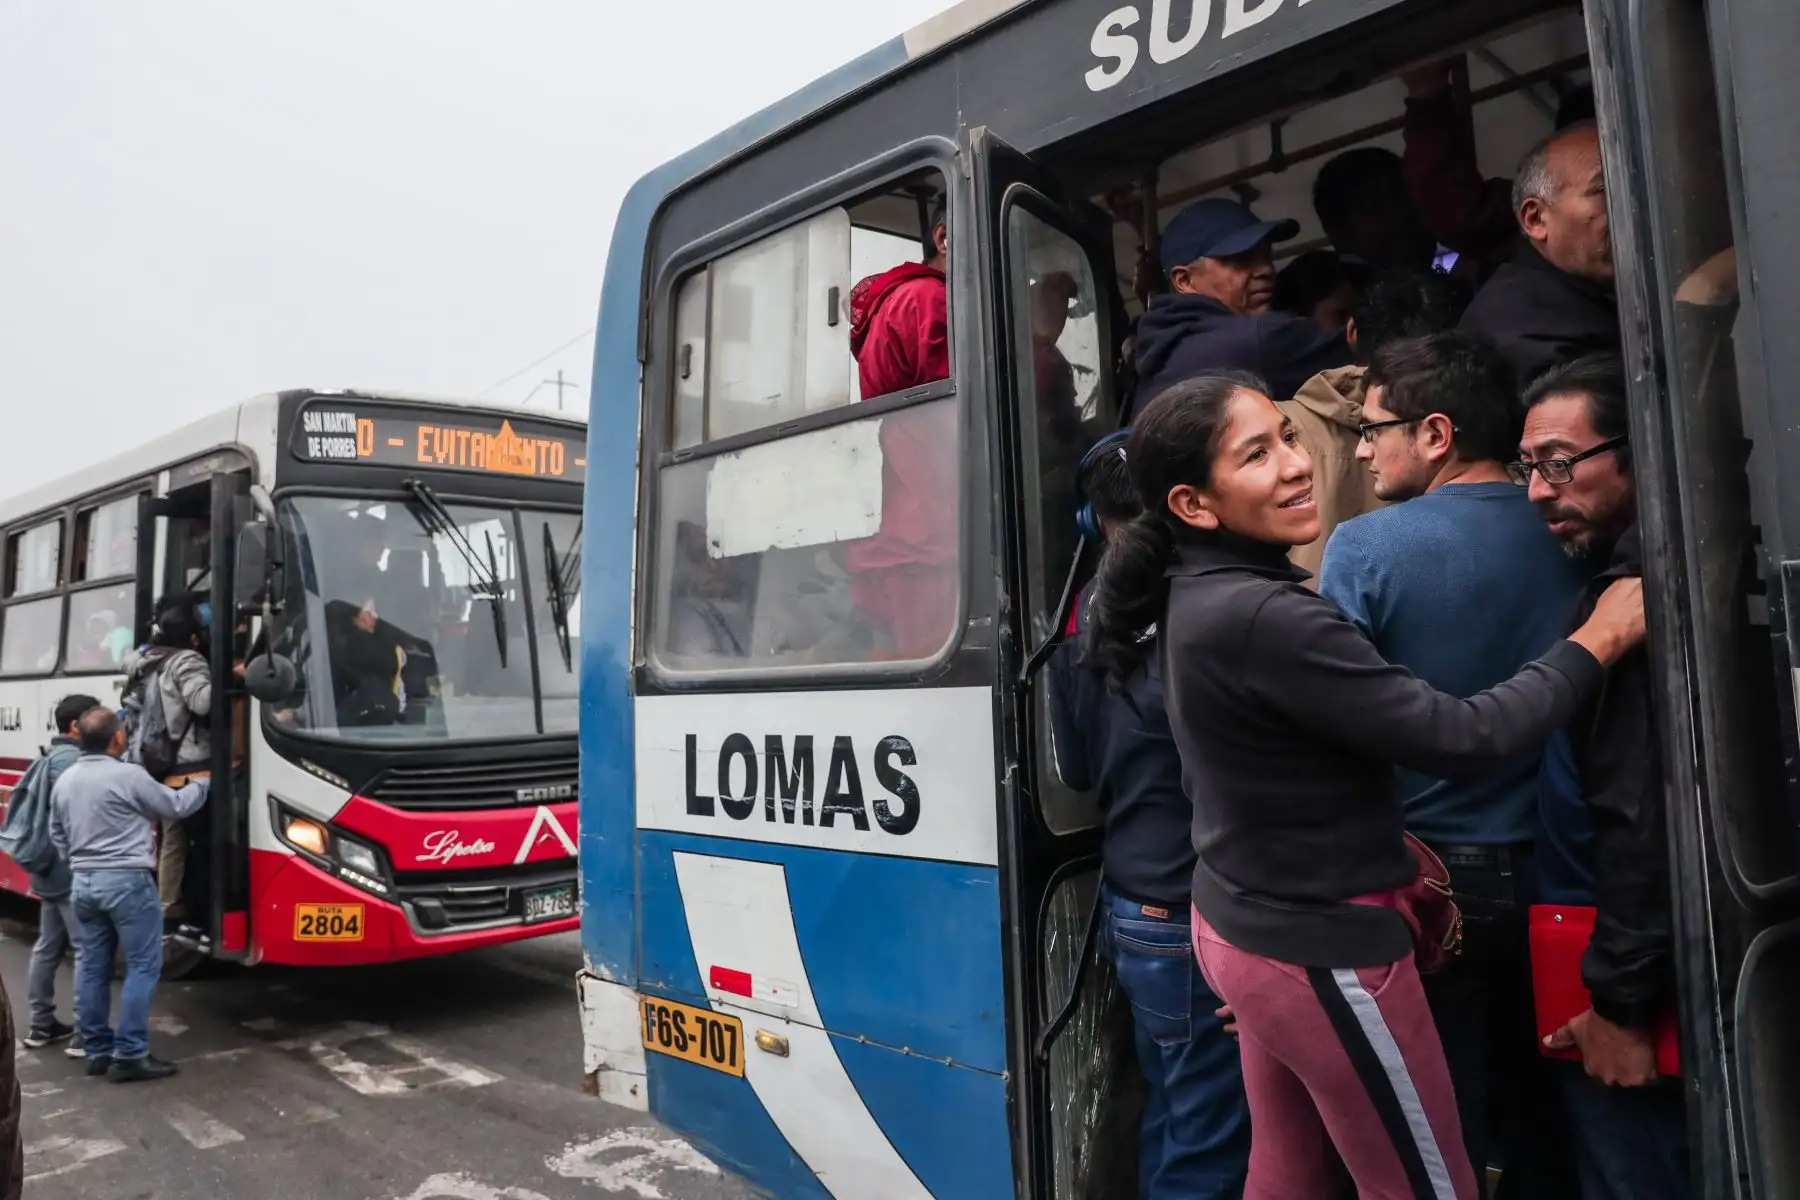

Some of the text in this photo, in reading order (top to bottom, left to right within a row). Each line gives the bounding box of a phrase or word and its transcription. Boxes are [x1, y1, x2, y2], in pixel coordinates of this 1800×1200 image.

[1085, 0, 1313, 91] SU
[303, 411, 356, 432] SAN MARTIN
[308, 436, 356, 458] DE PORRES
[418, 425, 564, 475] EVITANTO
[685, 733, 921, 836] LOMAS
[301, 914, 358, 936] 2804
[645, 1002, 737, 1067] F6S-707
